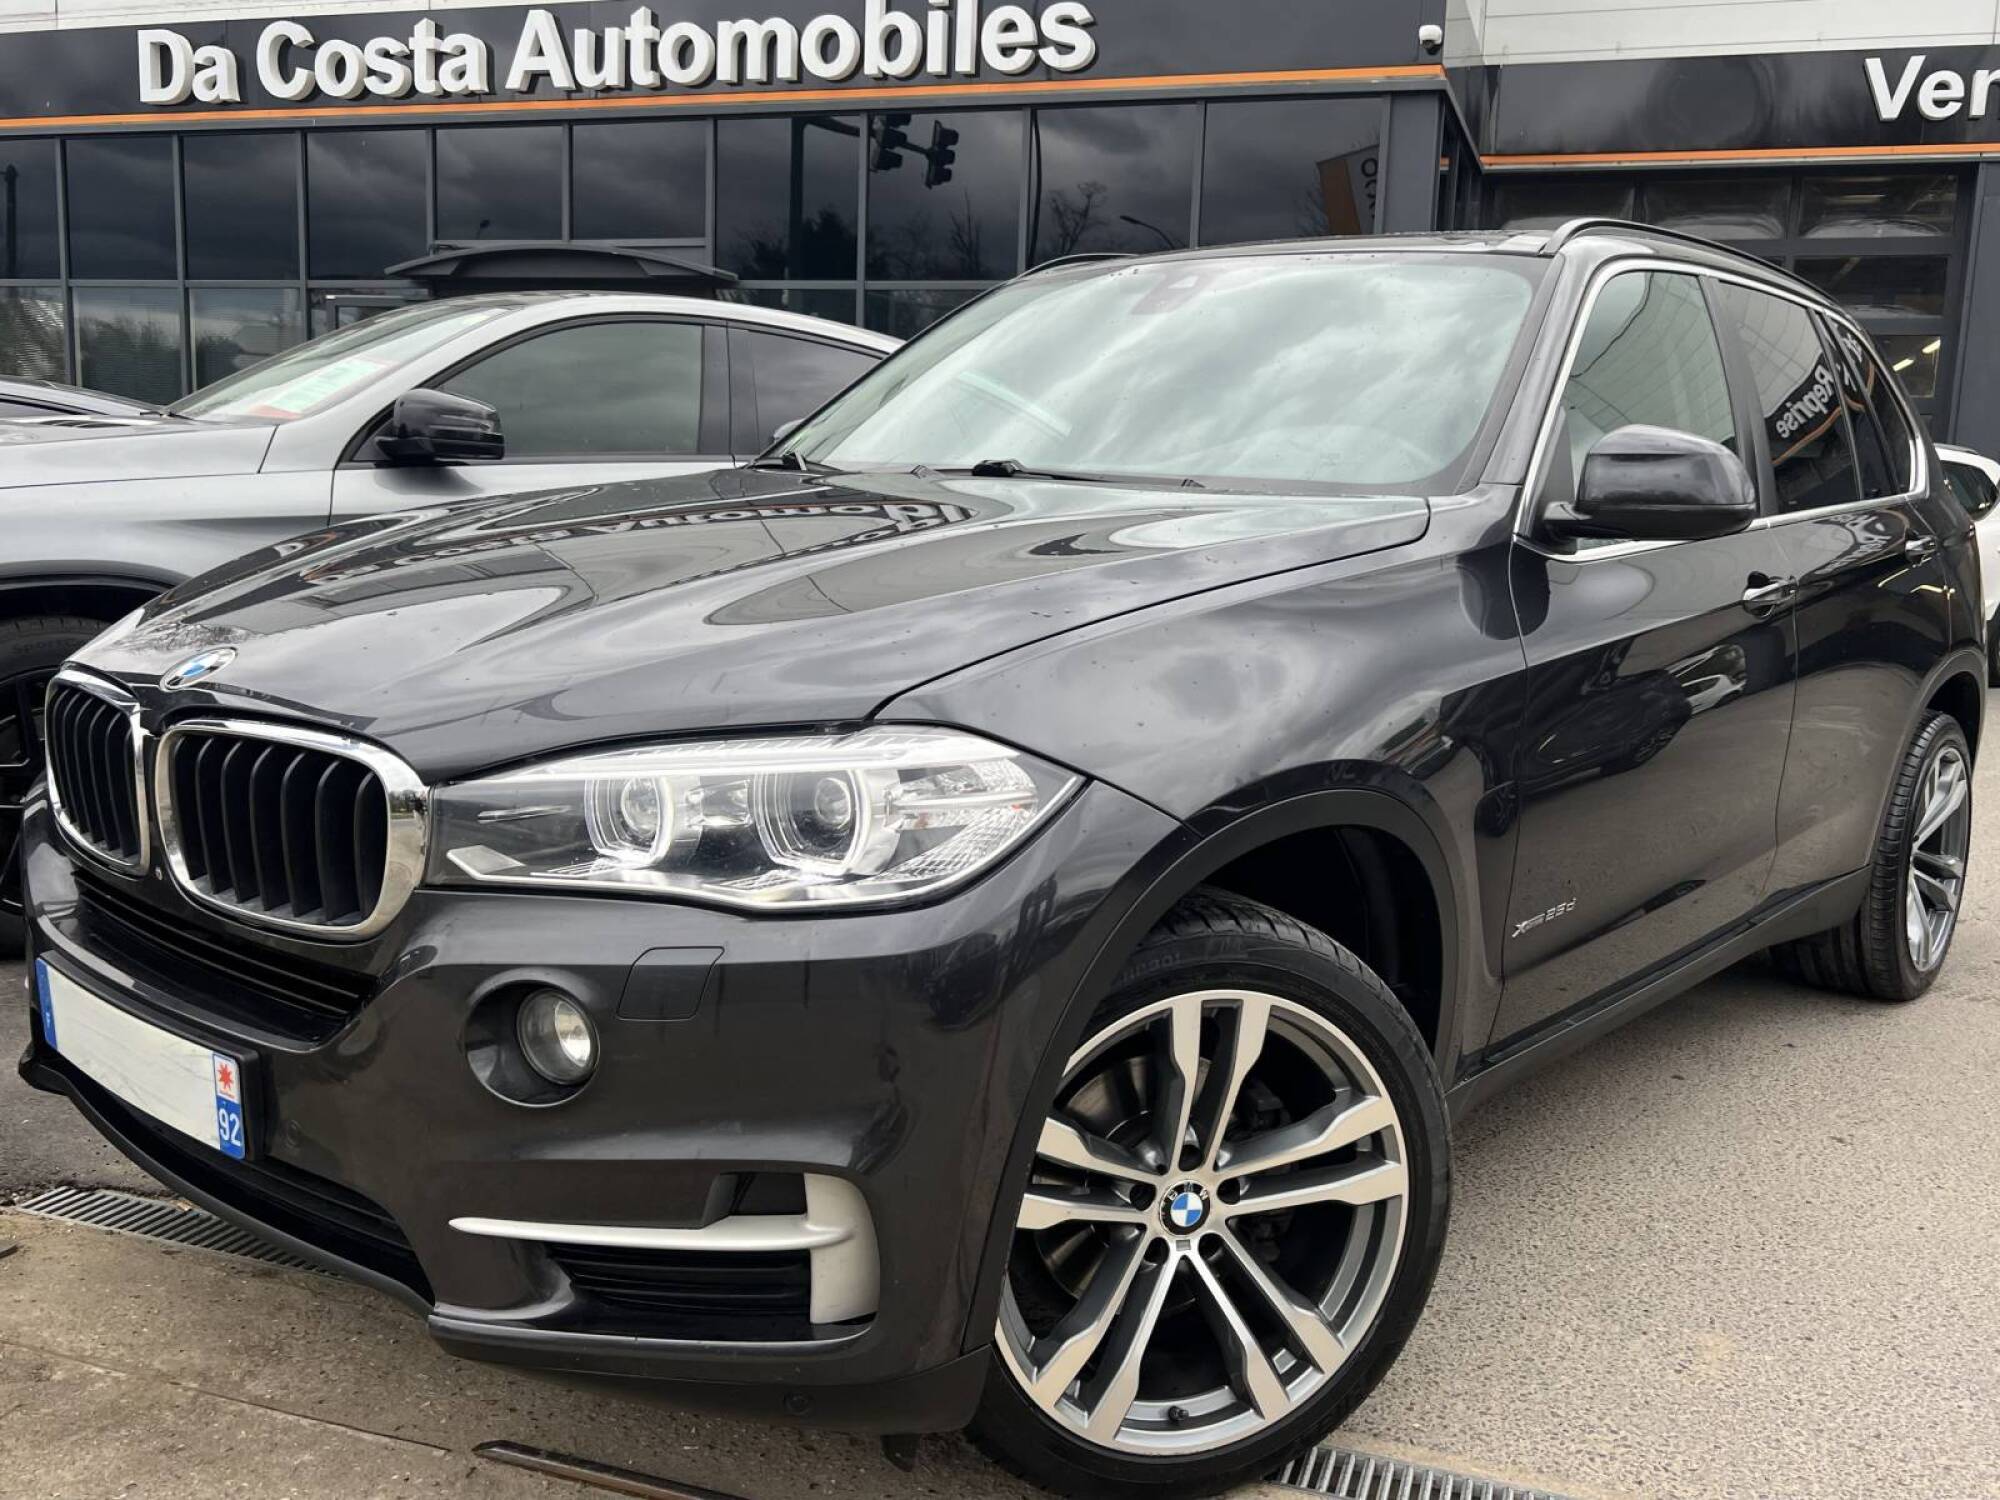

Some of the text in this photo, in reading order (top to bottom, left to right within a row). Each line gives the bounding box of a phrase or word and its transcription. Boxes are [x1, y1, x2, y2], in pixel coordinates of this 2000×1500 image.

[137, 0, 1097, 105] Da Costa Automobiles
[219, 1108, 241, 1147] 92
